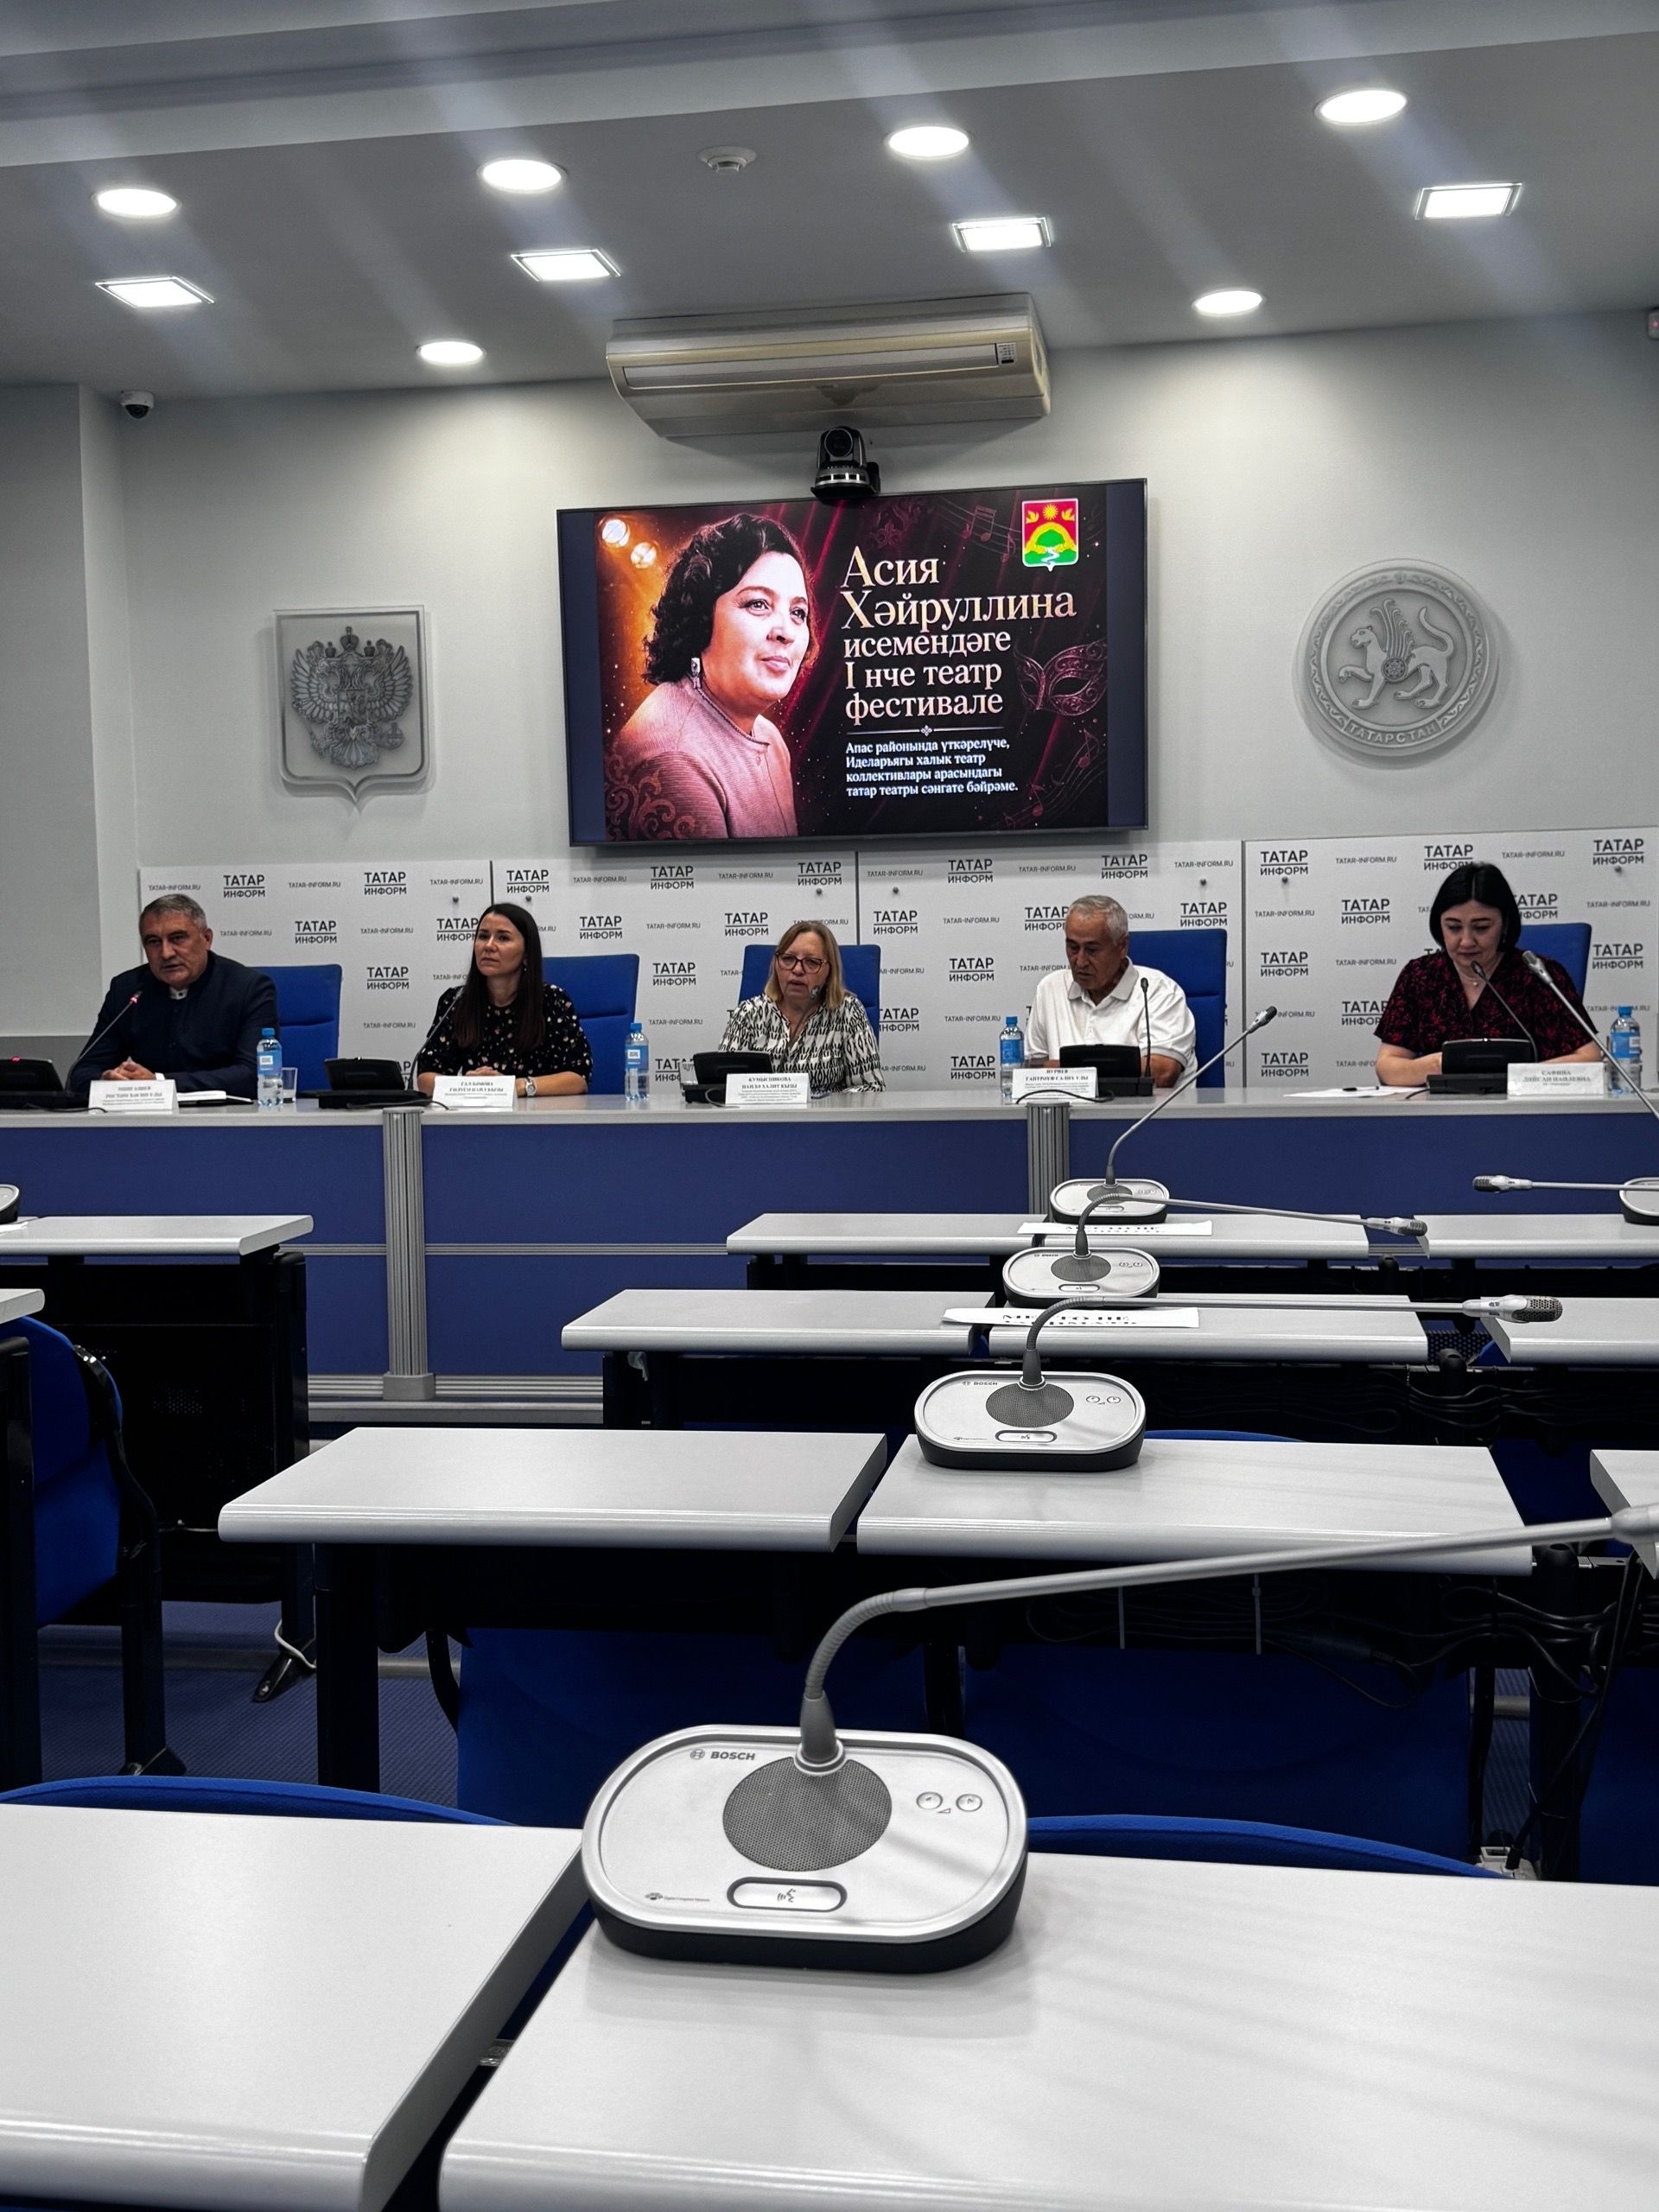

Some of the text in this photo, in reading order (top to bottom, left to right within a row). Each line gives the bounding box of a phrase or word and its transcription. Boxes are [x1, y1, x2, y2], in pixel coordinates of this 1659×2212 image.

[840, 546, 939, 588] Асия
[840, 589, 1077, 632] Хәйруллина
[843, 631, 1011, 658] исемендәге
[865, 667, 915, 688] нче
[924, 663, 1001, 690] театр
[846, 692, 1003, 725] фестивале
[1350, 723, 1438, 743] ТАТАРСТАН
[846, 739, 1010, 755] Апас районында үткәрелүче,
[917, 755, 951, 766] халык
[954, 753, 986, 765] театр
[847, 768, 1002, 782] коллективлары арасындагы
[847, 781, 1018, 798] татар театры сәнгате бәйрәме.
[1424, 844, 1473, 857] ТАТАР
[1593, 838, 1643, 852] ТАТАР
[1101, 854, 1147, 868] ТАТАР
[1261, 850, 1307, 864] ТАТАР
[1593, 855, 1643, 867] ИНФОРМ
[798, 861, 841, 874] ТАТАР
[948, 859, 992, 871] ТАТАР
[1261, 867, 1308, 875] ИНФОРМ
[365, 872, 406, 885] ТАТАР
[506, 870, 549, 881] ТАТАР
[650, 865, 693, 879] ТАТАР
[948, 874, 993, 883] ИНФОРМ
[1102, 870, 1147, 879] ИНФОРМ
[224, 874, 264, 887] ТАТАР
[798, 877, 842, 886] ИНФОРМ
[224, 888, 265, 898] ИНФОРМ
[507, 885, 550, 893] ИНФОРМ
[1342, 899, 1389, 911] ТАТАР
[1514, 893, 1557, 906] АТАР
[1180, 902, 1227, 916] ТАТАР
[1520, 911, 1557, 919] ФОРМ
[437, 918, 479, 930] ТАТАР
[580, 916, 622, 929] ТАТАР
[725, 912, 768, 924] ТАТАР
[874, 911, 917, 924] ТАТАР
[1342, 915, 1389, 924] ИНФОРМ
[295, 921, 336, 933] ТАТАР
[296, 934, 337, 944] ИНФОРМ
[1592, 942, 1643, 956] ТАТАР
[1261, 951, 1308, 963] ТАТАР
[653, 963, 696, 976] ТАТАР
[950, 957, 994, 971] ТАТАР
[367, 967, 408, 977] ТАТАР
[1261, 968, 1308, 976] ИНФОРМ
[880, 1007, 919, 1020] АТАР
[655, 1058, 694, 1070] ТАТ
[950, 1056, 995, 1069] ТАТАР
[1262, 1052, 1308, 1065] ТАТАР
[710, 1751, 755, 1761] BOSCH
